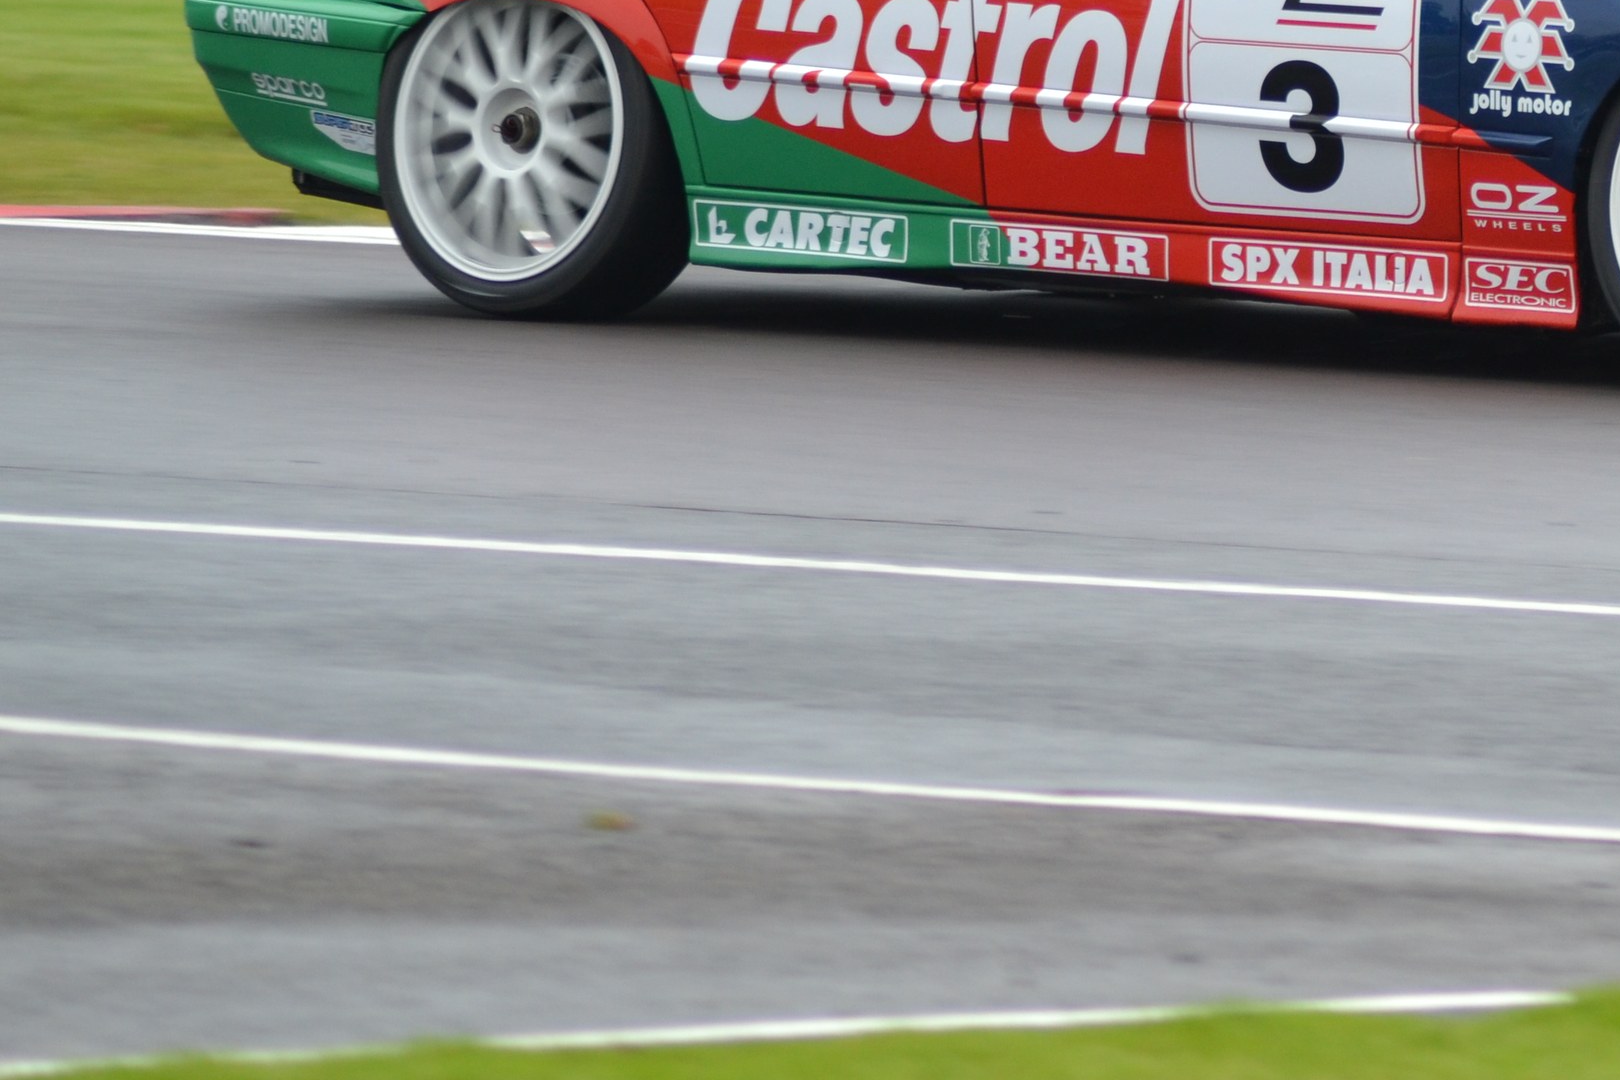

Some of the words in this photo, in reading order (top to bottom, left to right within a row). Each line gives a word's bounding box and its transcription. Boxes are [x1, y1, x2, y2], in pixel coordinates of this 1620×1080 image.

[233, 7, 329, 43] PROMODESIGN
[252, 72, 326, 98] sparco
[1469, 89, 1512, 118] jolly
[1517, 93, 1572, 116] motor
[1259, 59, 1345, 193] 3
[1470, 182, 1560, 213] OZ
[744, 208, 896, 258] CARTEC
[1474, 219, 1562, 233] WHEELS
[1006, 227, 1151, 276] BEAR
[1220, 243, 1298, 287] SPX
[1313, 248, 1436, 296] ITALIA
[1471, 264, 1567, 294] SEC
[1470, 291, 1567, 308] ELECTRONIC
